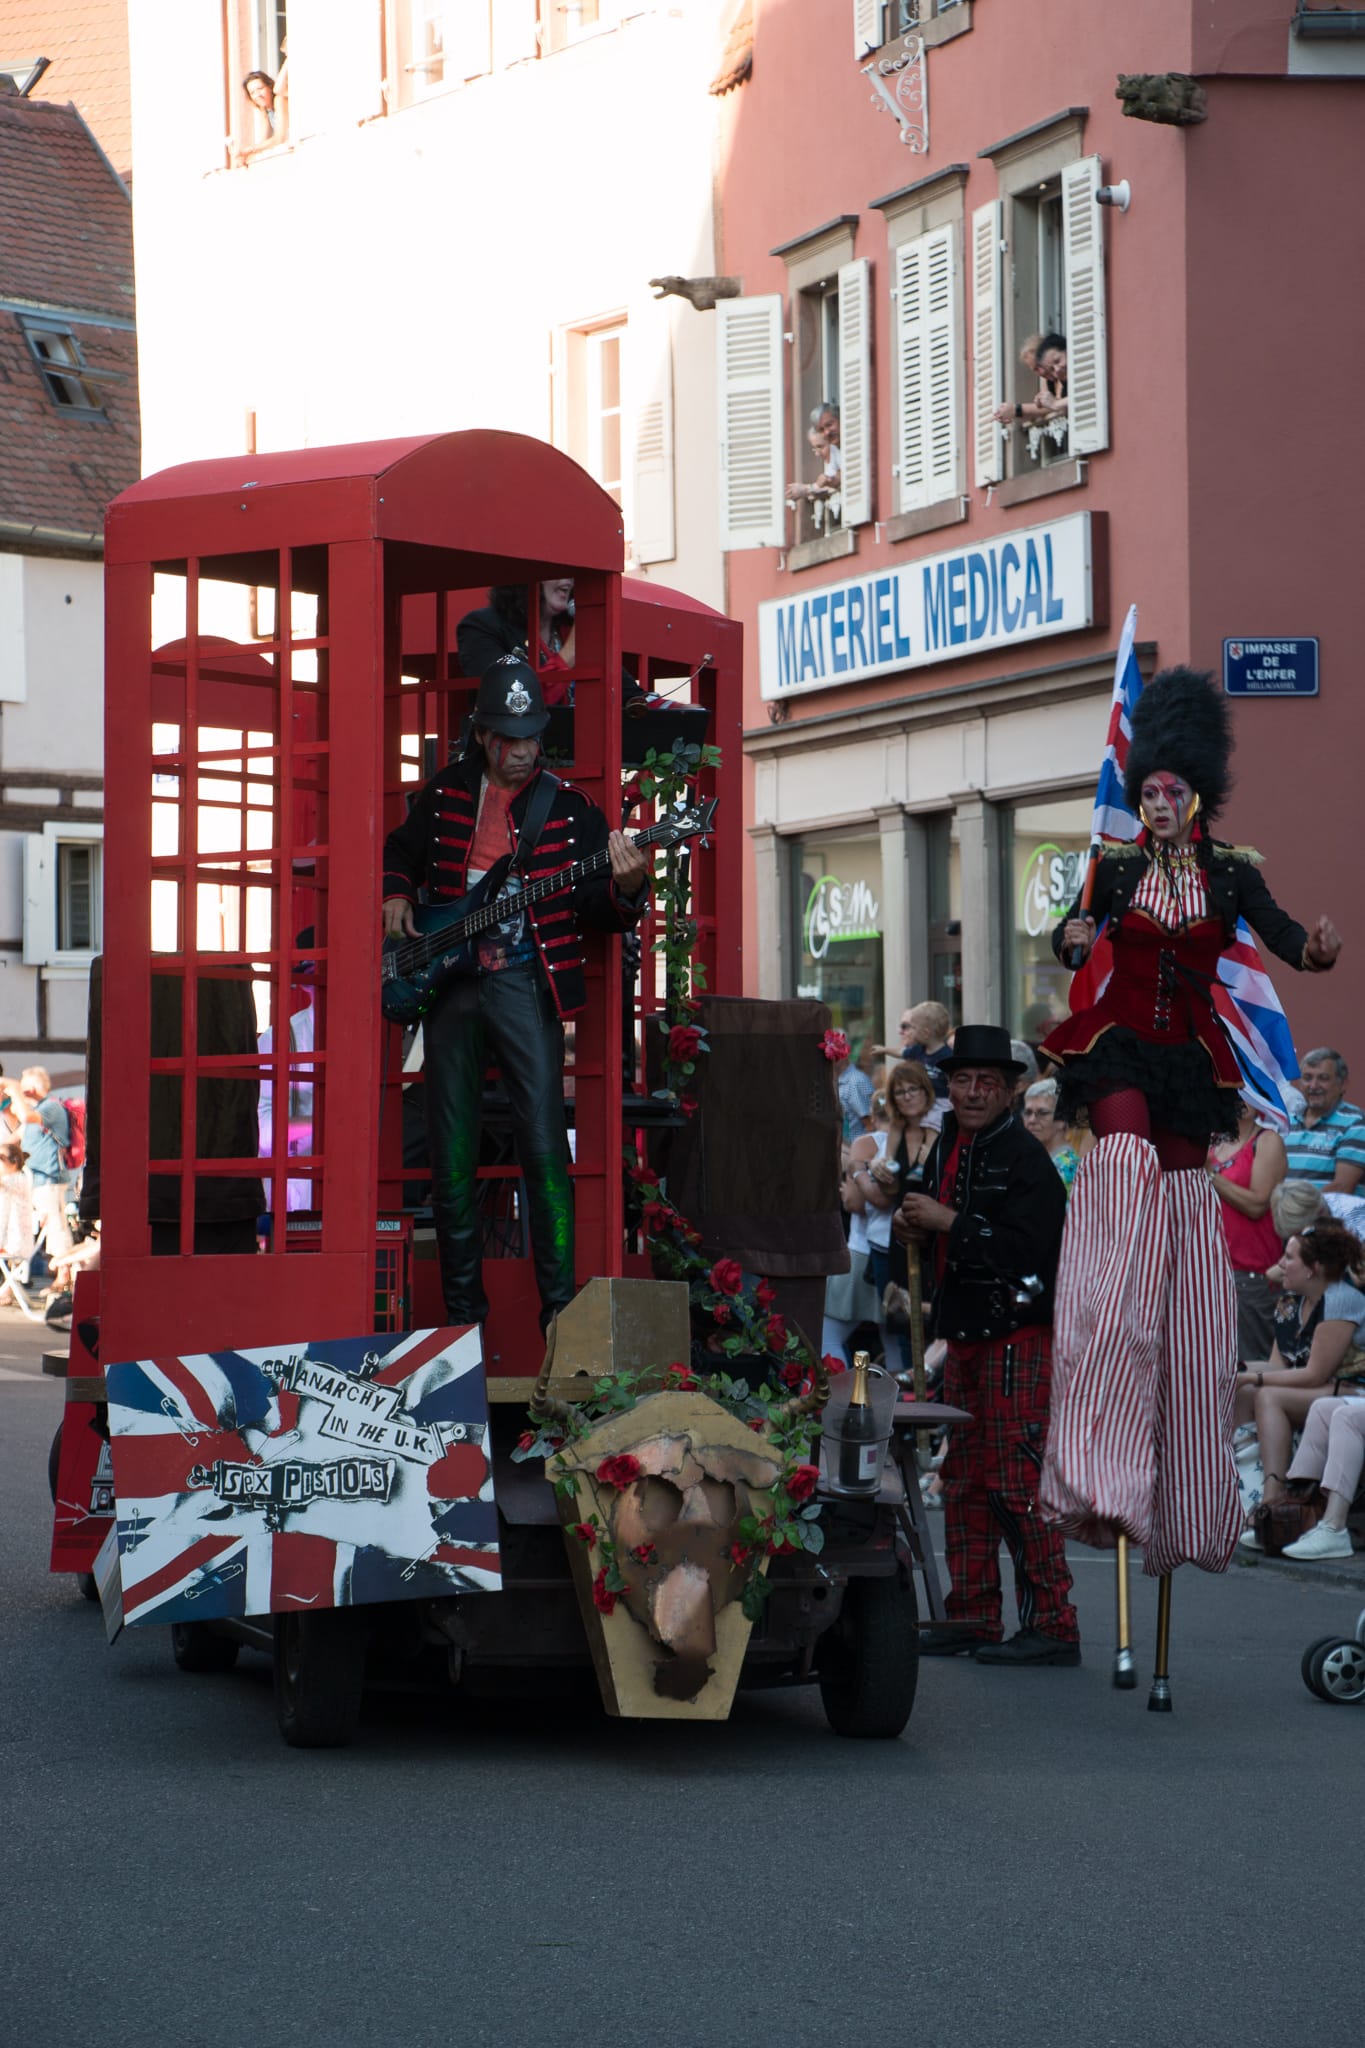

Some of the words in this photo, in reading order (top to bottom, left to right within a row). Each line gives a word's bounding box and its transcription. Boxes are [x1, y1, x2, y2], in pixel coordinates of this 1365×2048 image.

[777, 576, 910, 687] MATERIEL
[923, 534, 1063, 651] MEDICAL
[1245, 642, 1297, 654] IMPASSE
[1246, 668, 1297, 680] L'ENFER
[1262, 656, 1280, 667] DE
[295, 1369, 387, 1413] ANARCHY
[330, 1415, 349, 1435] IN
[356, 1422, 388, 1443] THE
[394, 1429, 433, 1455] U.K.
